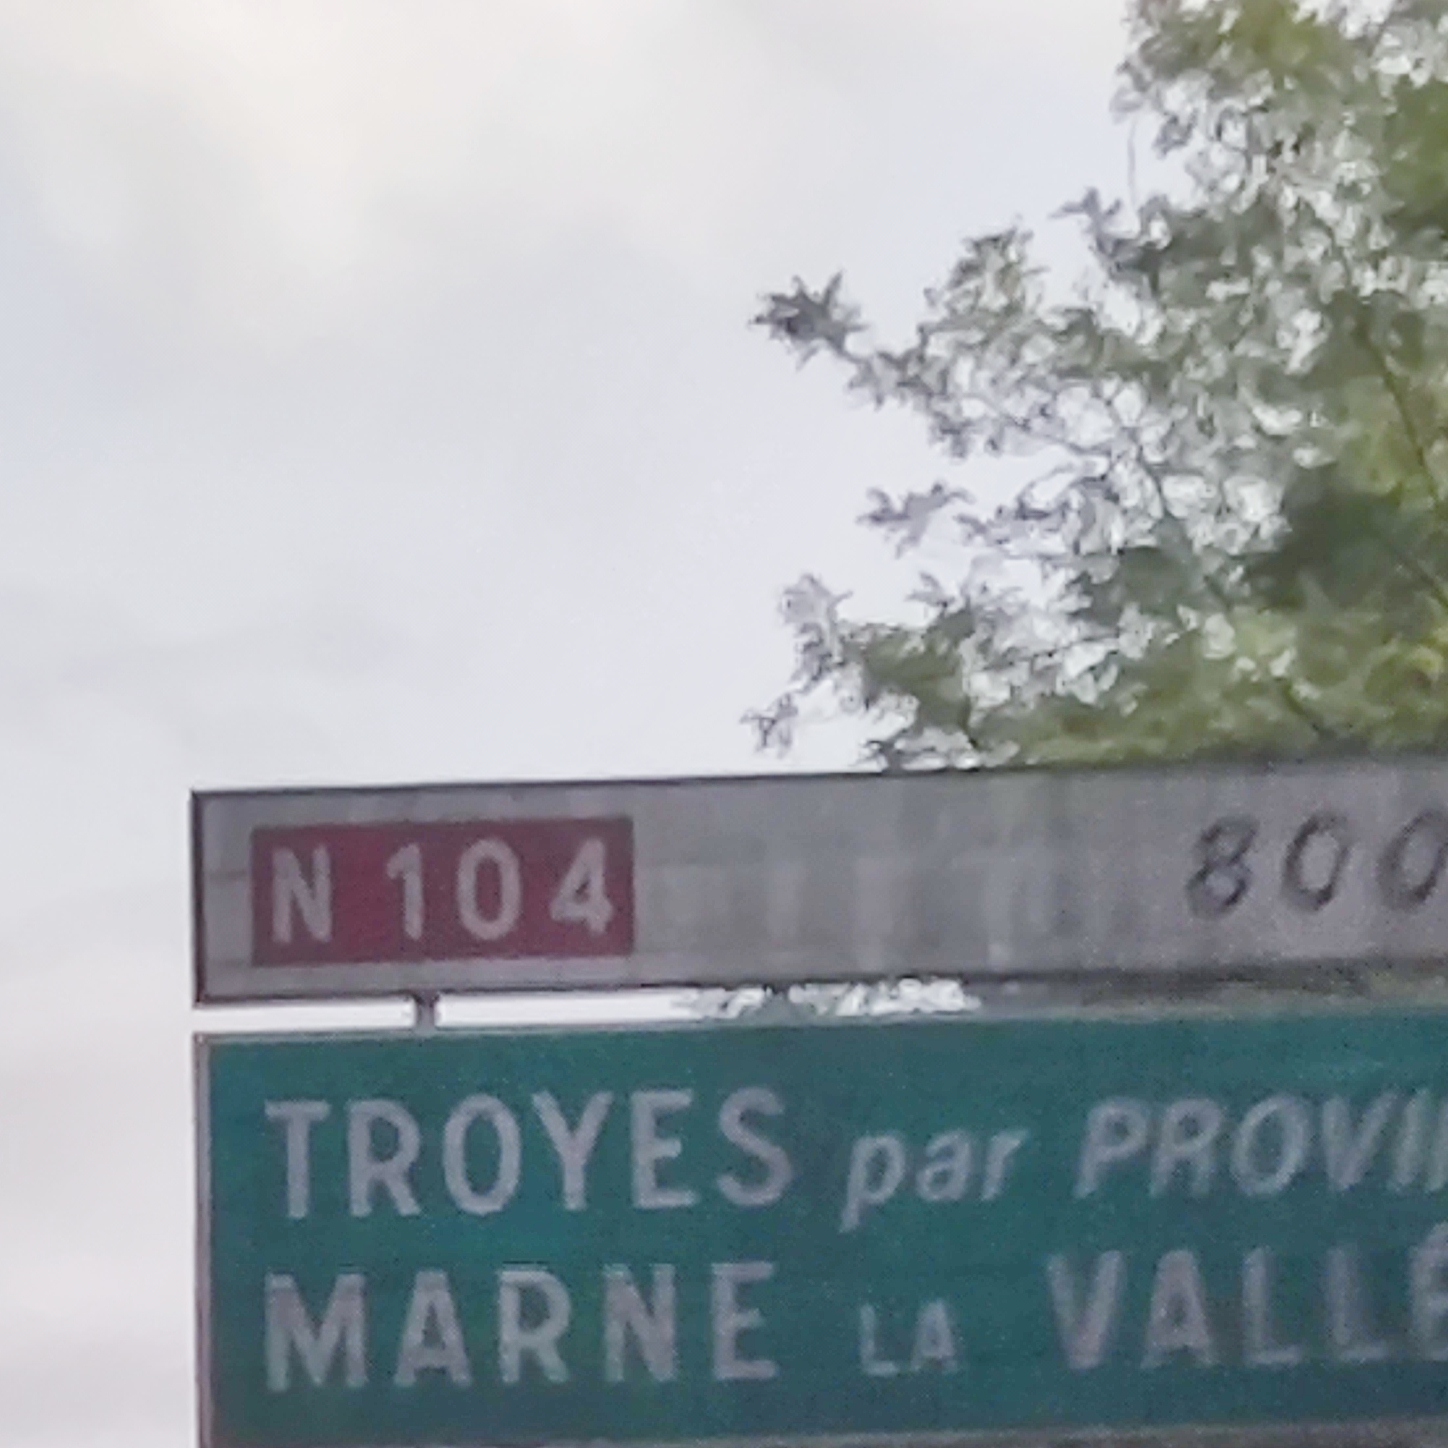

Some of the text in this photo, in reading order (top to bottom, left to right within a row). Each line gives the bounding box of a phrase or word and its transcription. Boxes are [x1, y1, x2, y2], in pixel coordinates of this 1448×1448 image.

[264, 1086, 794, 1219] TROYES
[839, 1128, 1030, 1233] par
[264, 1262, 779, 1392] MARNE
[859, 1300, 959, 1376] LA
